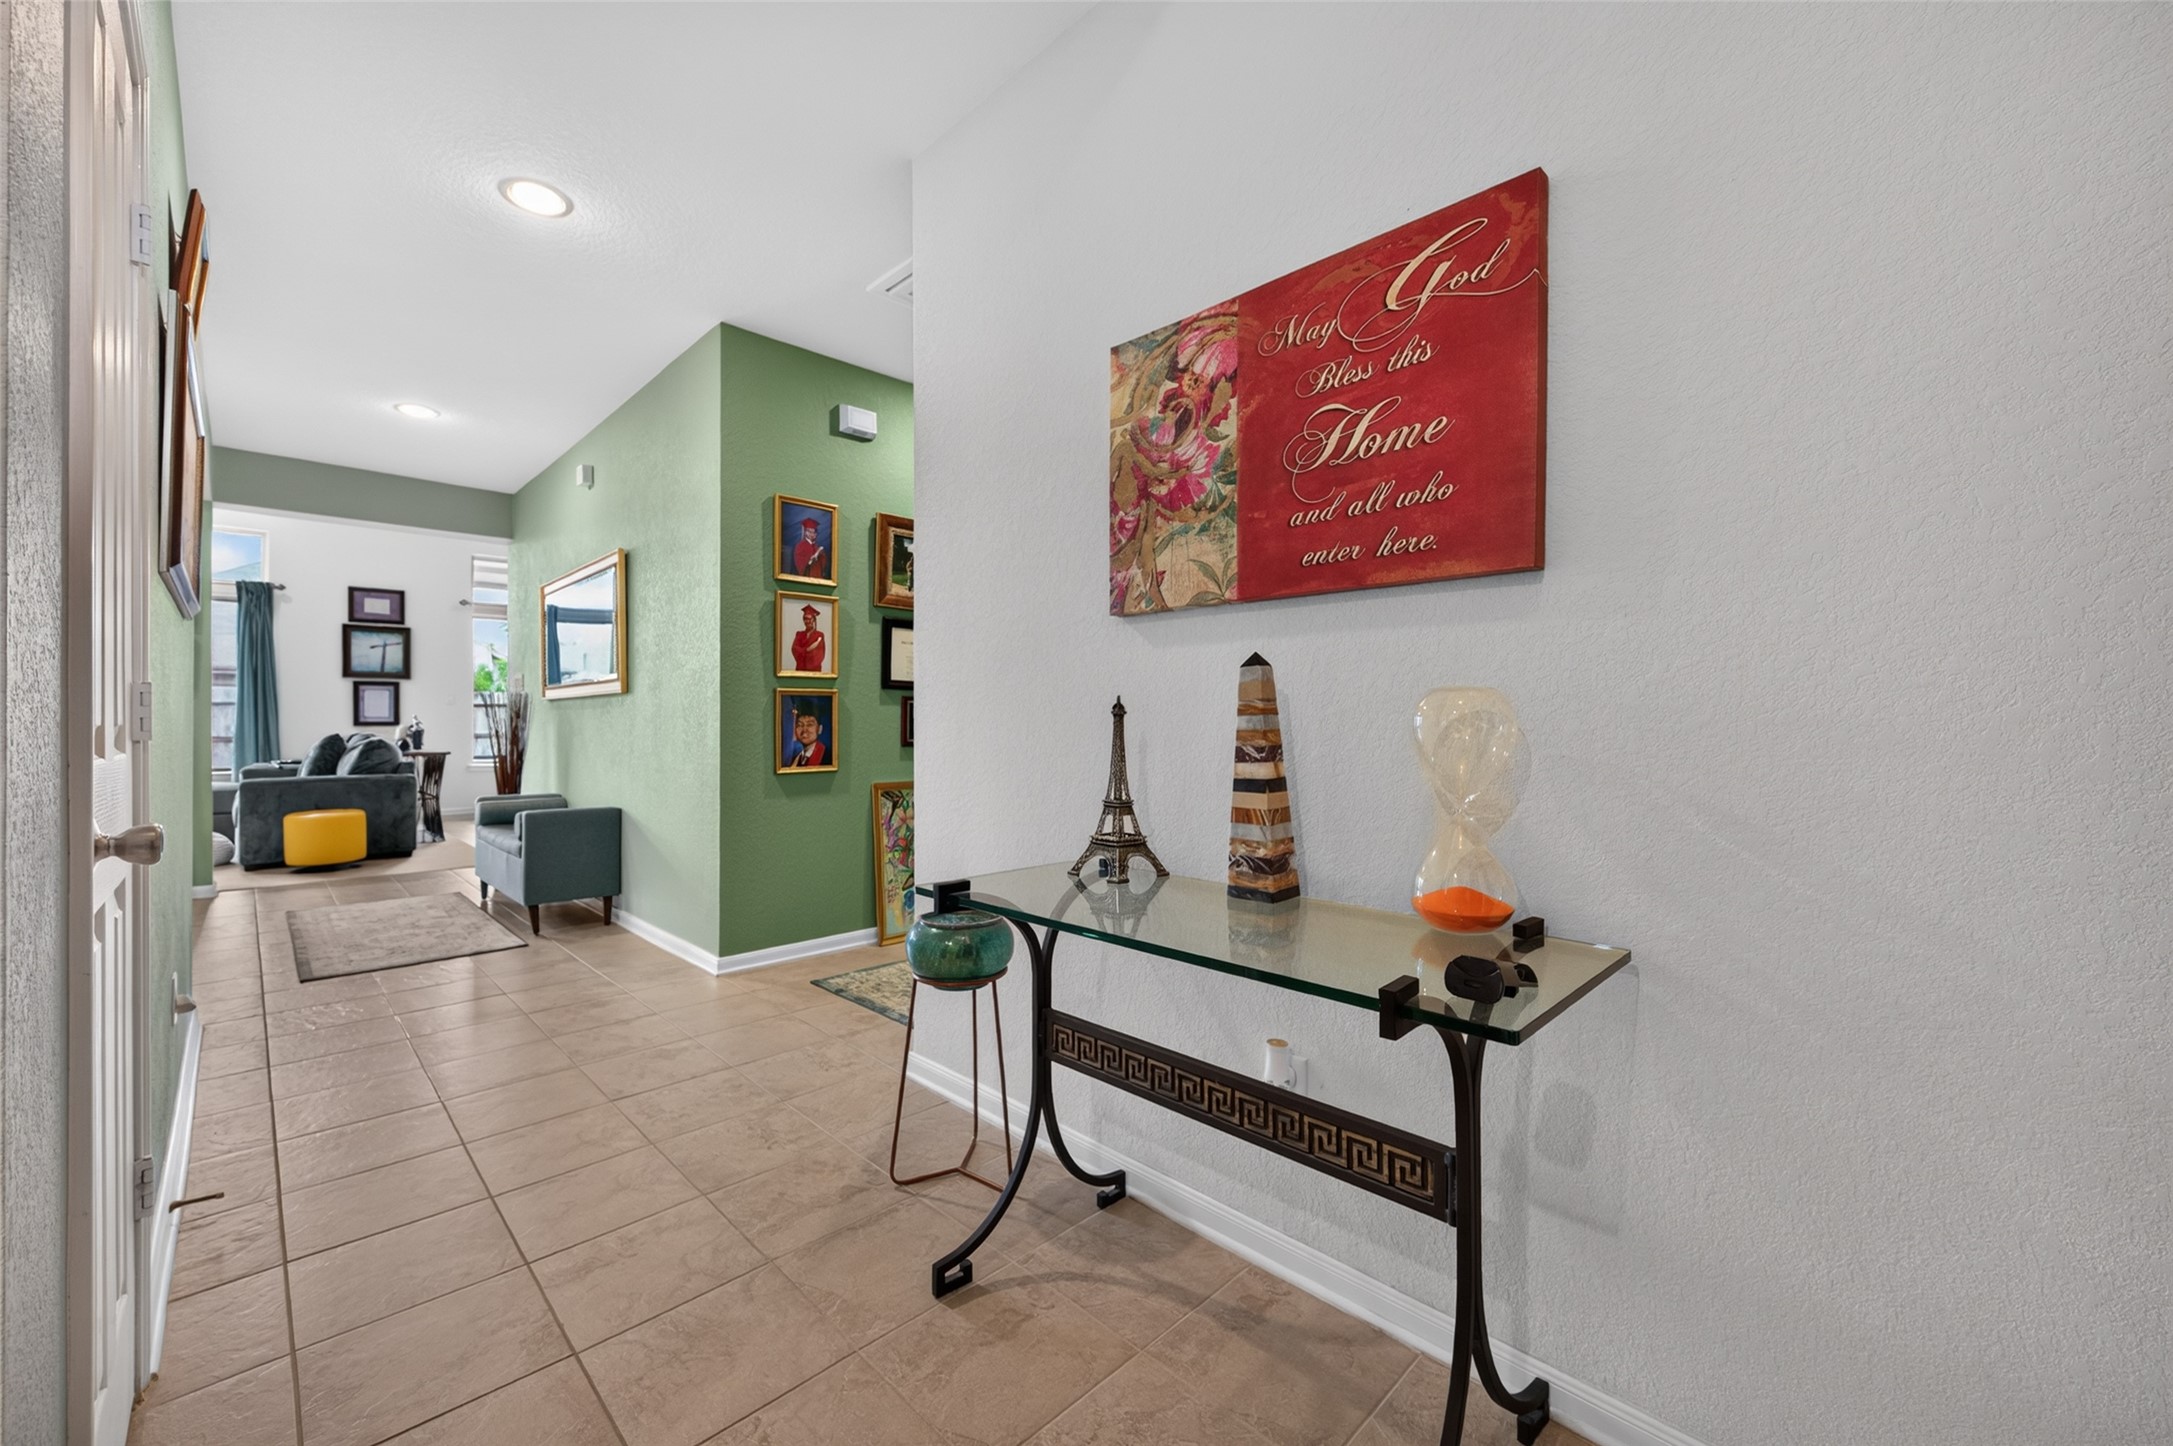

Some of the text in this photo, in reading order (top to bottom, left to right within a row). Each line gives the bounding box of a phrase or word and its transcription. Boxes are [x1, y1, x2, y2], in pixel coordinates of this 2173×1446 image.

[1258, 218, 1514, 357] May God
[1296, 334, 1440, 398] Bless this
[1283, 396, 1456, 503] Home
[1290, 470, 1460, 527] and all who
[1302, 526, 1437, 567] enter here.
